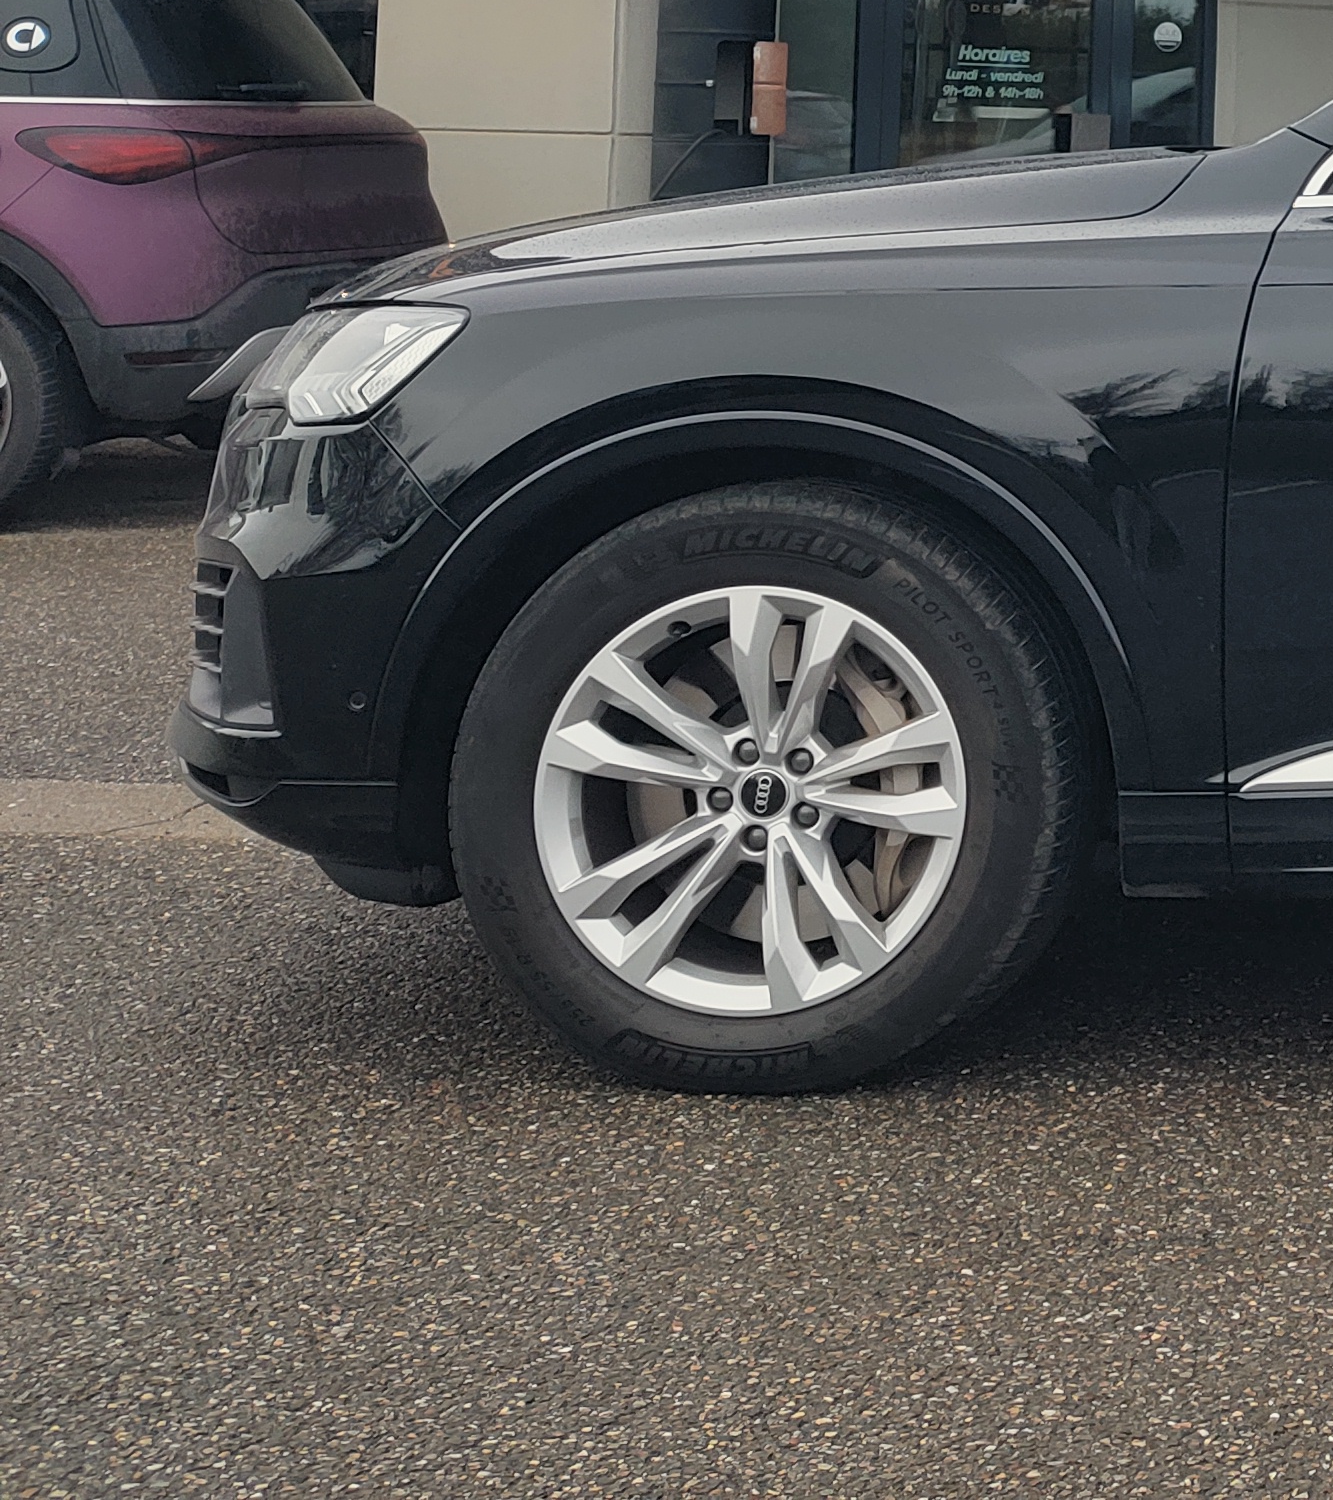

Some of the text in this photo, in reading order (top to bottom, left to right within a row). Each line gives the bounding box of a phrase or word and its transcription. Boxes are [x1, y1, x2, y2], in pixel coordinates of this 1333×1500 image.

[957, 44, 1031, 63] Horaires
[945, 68, 979, 81] Lundi
[989, 71, 1045, 83] vendredi
[984, 85, 995, 98] &
[682, 523, 880, 574] MICHELIN
[892, 577, 952, 624] PILOT
[948, 630, 1000, 697] SPORT
